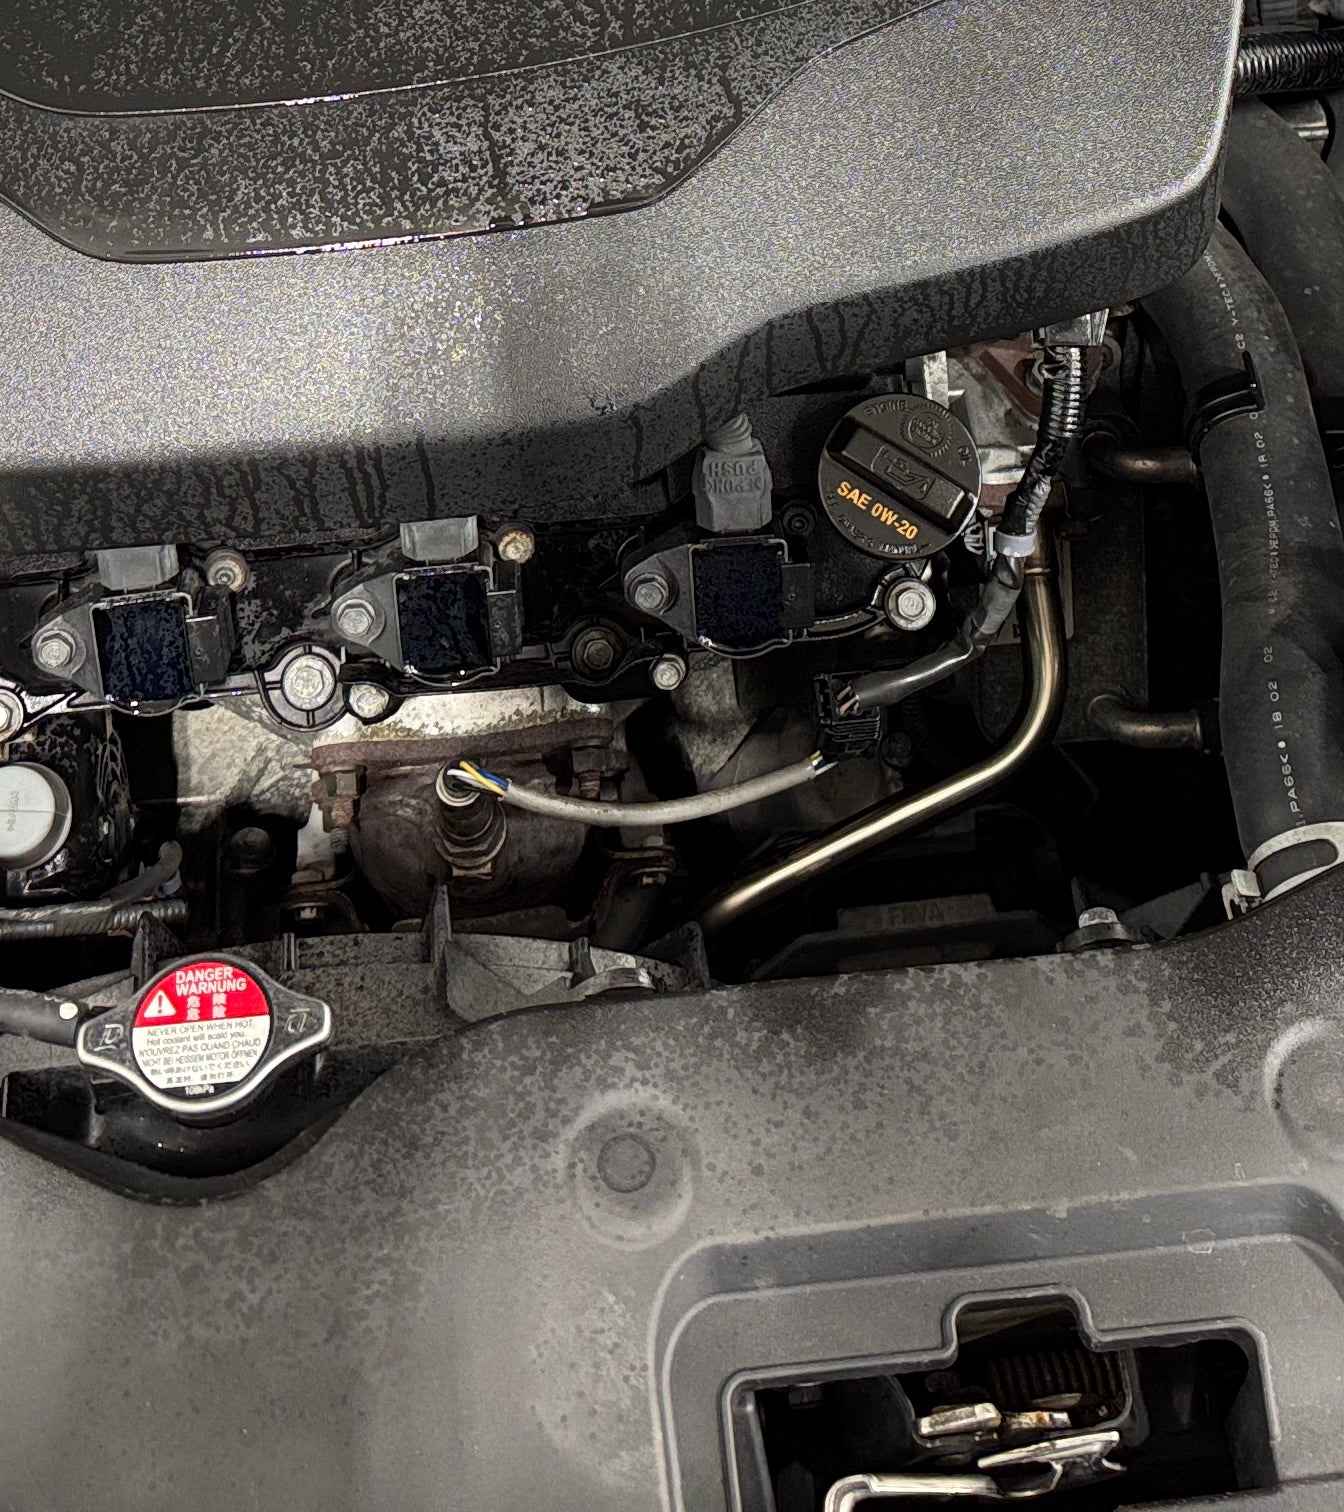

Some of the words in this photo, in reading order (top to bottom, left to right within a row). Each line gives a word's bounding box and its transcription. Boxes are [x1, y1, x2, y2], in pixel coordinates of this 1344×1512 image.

[708, 459, 759, 478] PUSH
[837, 481, 873, 511] SAE
[870, 502, 919, 540] 0W-20
[1267, 681, 1280, 703] 02
[175, 966, 234, 984] DANGER
[175, 977, 247, 997] WARNUNG
[147, 1026, 177, 1037] NEVER
[178, 1024, 204, 1034] OPEN
[206, 1021, 233, 1031] WHEN
[235, 1019, 254, 1029] HOT
[181, 1043, 199, 1053] PAS
[200, 1040, 231, 1052] QUAND
[232, 1038, 261, 1048] CHAUD
